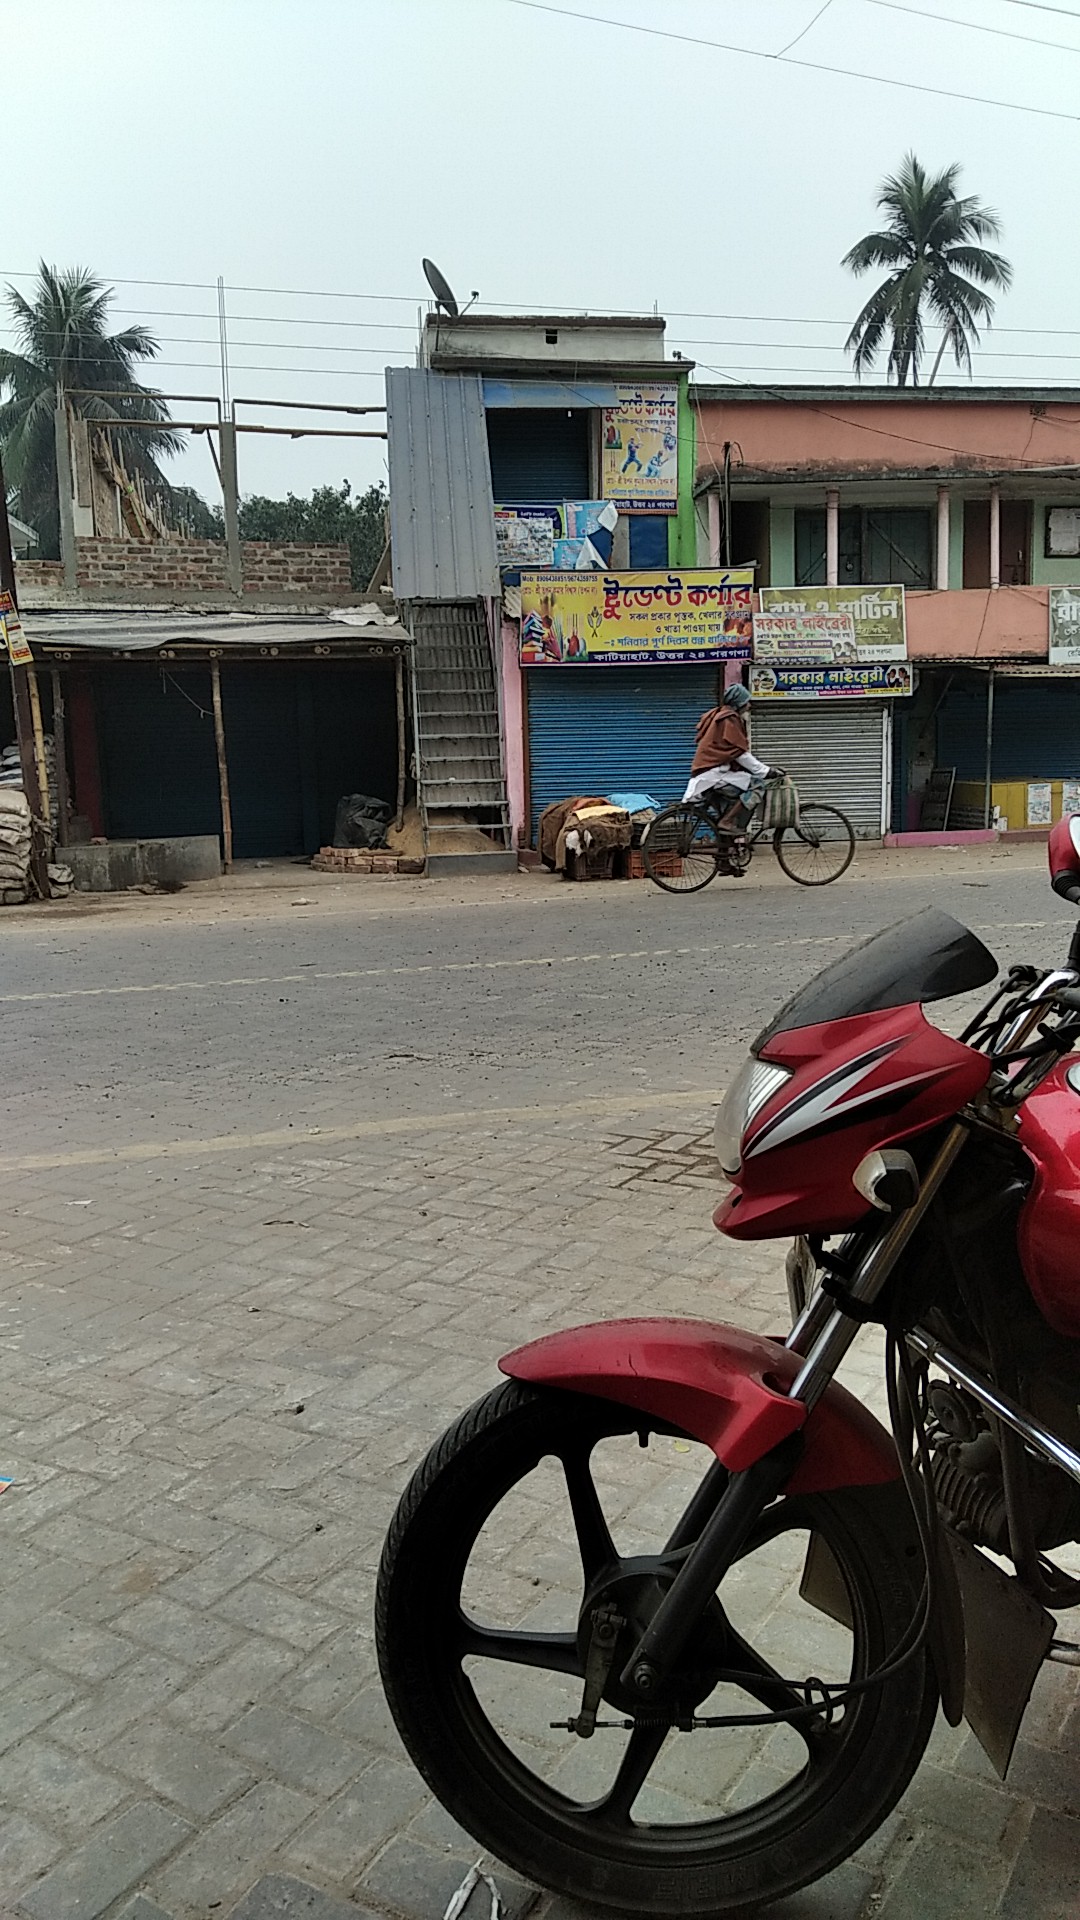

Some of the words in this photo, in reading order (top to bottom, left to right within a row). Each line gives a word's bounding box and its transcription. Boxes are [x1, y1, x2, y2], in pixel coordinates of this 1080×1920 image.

[687, 574, 753, 608] কর্ণার
[629, 612, 648, 622] সকল
[650, 612, 672, 620] প্রকার
[698, 610, 722, 620] খেলার
[1056, 601, 1080, 624] রা
[664, 625, 681, 633] খাতা
[683, 624, 706, 634] পাওয়া
[708, 623, 721, 632] যায়
[754, 618, 798, 632] সরকার
[800, 614, 852, 632] লাইব্রেরী
[617, 636, 648, 647] শনিবার
[652, 635, 664, 648] পূর্ণ
[666, 635, 689, 646] দিবস
[691, 636, 705, 646] বন্ধ
[592, 651, 653, 662] কাটিয়াহাট,
[656, 650, 685, 660] উত্তর
[688, 652, 706, 660] ২৪
[710, 649, 750, 658] পরগণা
[778, 671, 826, 684] সরকার
[828, 666, 884, 684] লাইব্রেরী
